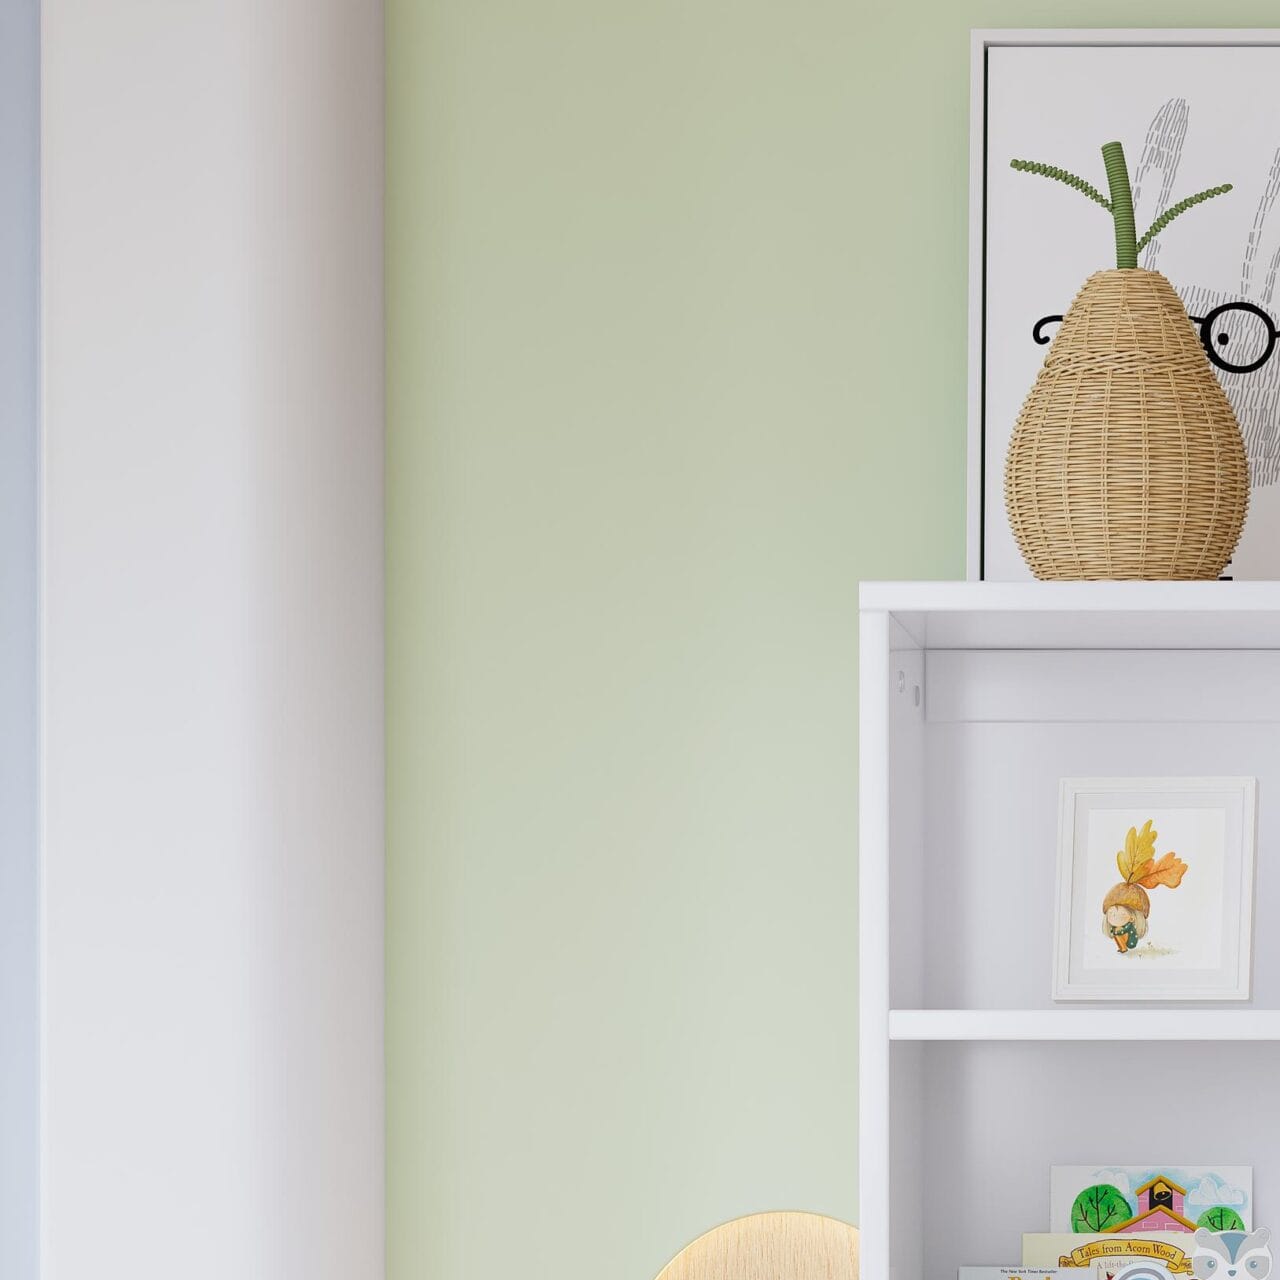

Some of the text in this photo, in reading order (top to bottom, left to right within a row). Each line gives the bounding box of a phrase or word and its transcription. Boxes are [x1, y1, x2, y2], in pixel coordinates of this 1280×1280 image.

[1078, 1242, 1177, 1260] Tales from Acorn Wood
